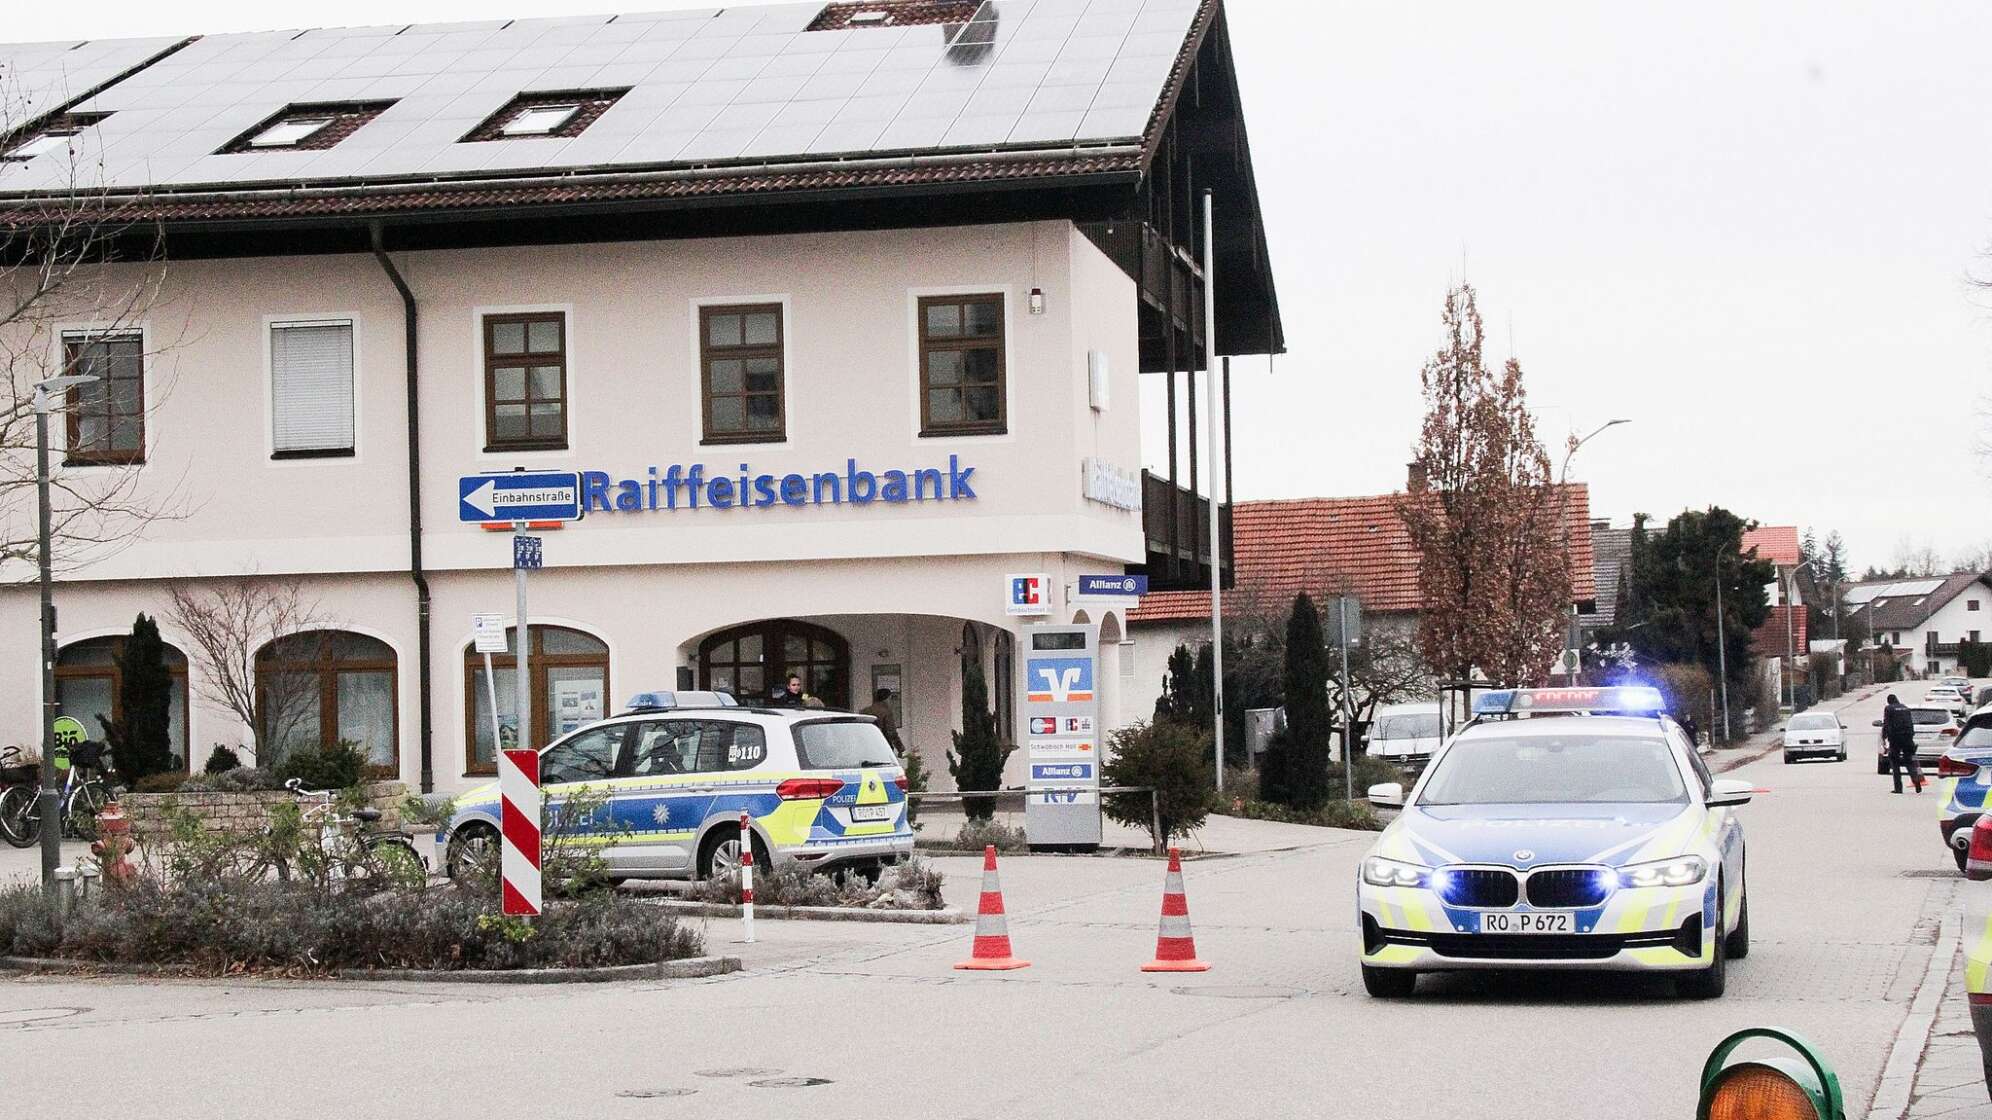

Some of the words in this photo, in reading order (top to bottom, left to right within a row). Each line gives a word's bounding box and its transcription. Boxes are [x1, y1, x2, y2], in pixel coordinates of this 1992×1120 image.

[583, 454, 977, 513] Raiffeisenbank
[492, 491, 571, 503] Einbahnstraße
[1089, 580, 1122, 590] Allianz
[740, 745, 760, 760] 110
[1042, 767, 1071, 776] Allianz
[832, 794, 857, 804] POLIZEI
[1487, 915, 1508, 930] RO
[1520, 915, 1531, 931] P
[1535, 915, 1567, 931] 672
